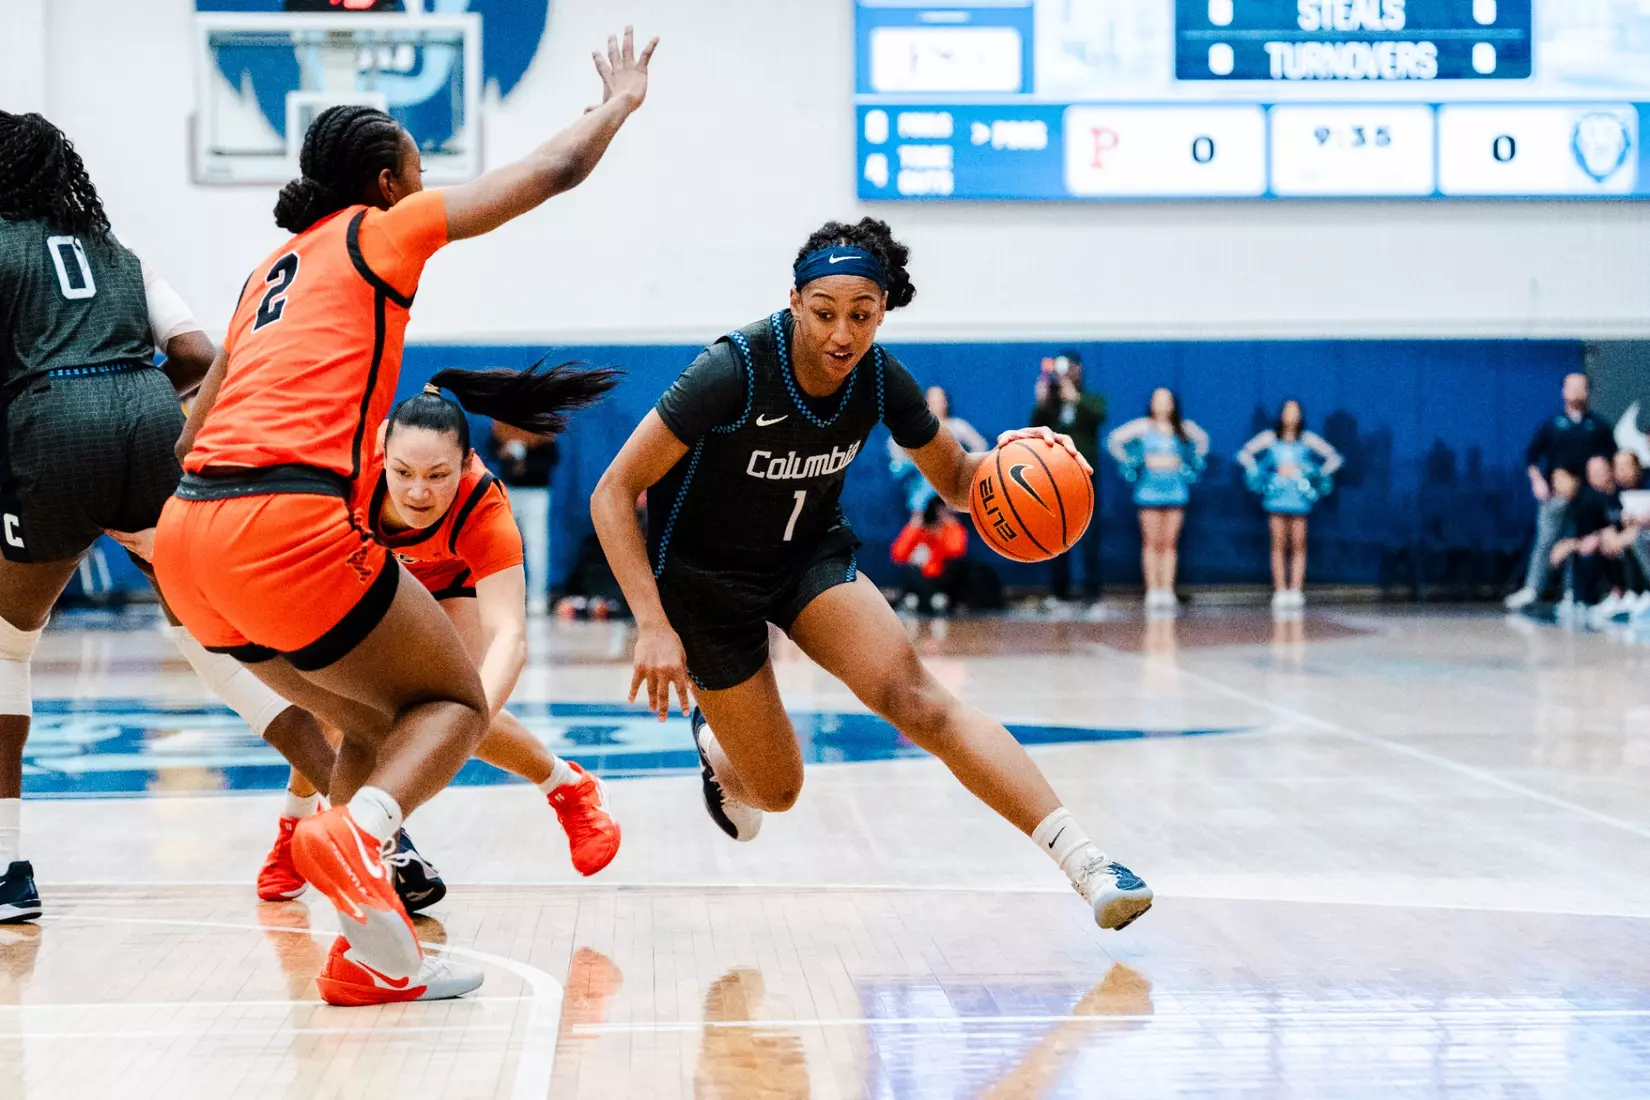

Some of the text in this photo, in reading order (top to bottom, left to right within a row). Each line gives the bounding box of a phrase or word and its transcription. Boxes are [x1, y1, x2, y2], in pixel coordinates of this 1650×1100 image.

[1297, 0, 1406, 31] STEALS
[1265, 41, 1438, 80] TURNOVERS
[1089, 127, 1119, 168] P
[1192, 136, 1215, 163] 0
[1492, 135, 1516, 162] 0
[47, 235, 97, 300] 0
[252, 250, 300, 334] 2
[746, 439, 861, 480] Columbia
[783, 490, 807, 541] 1
[979, 476, 1017, 543] ELITE
[3, 513, 25, 549] C
